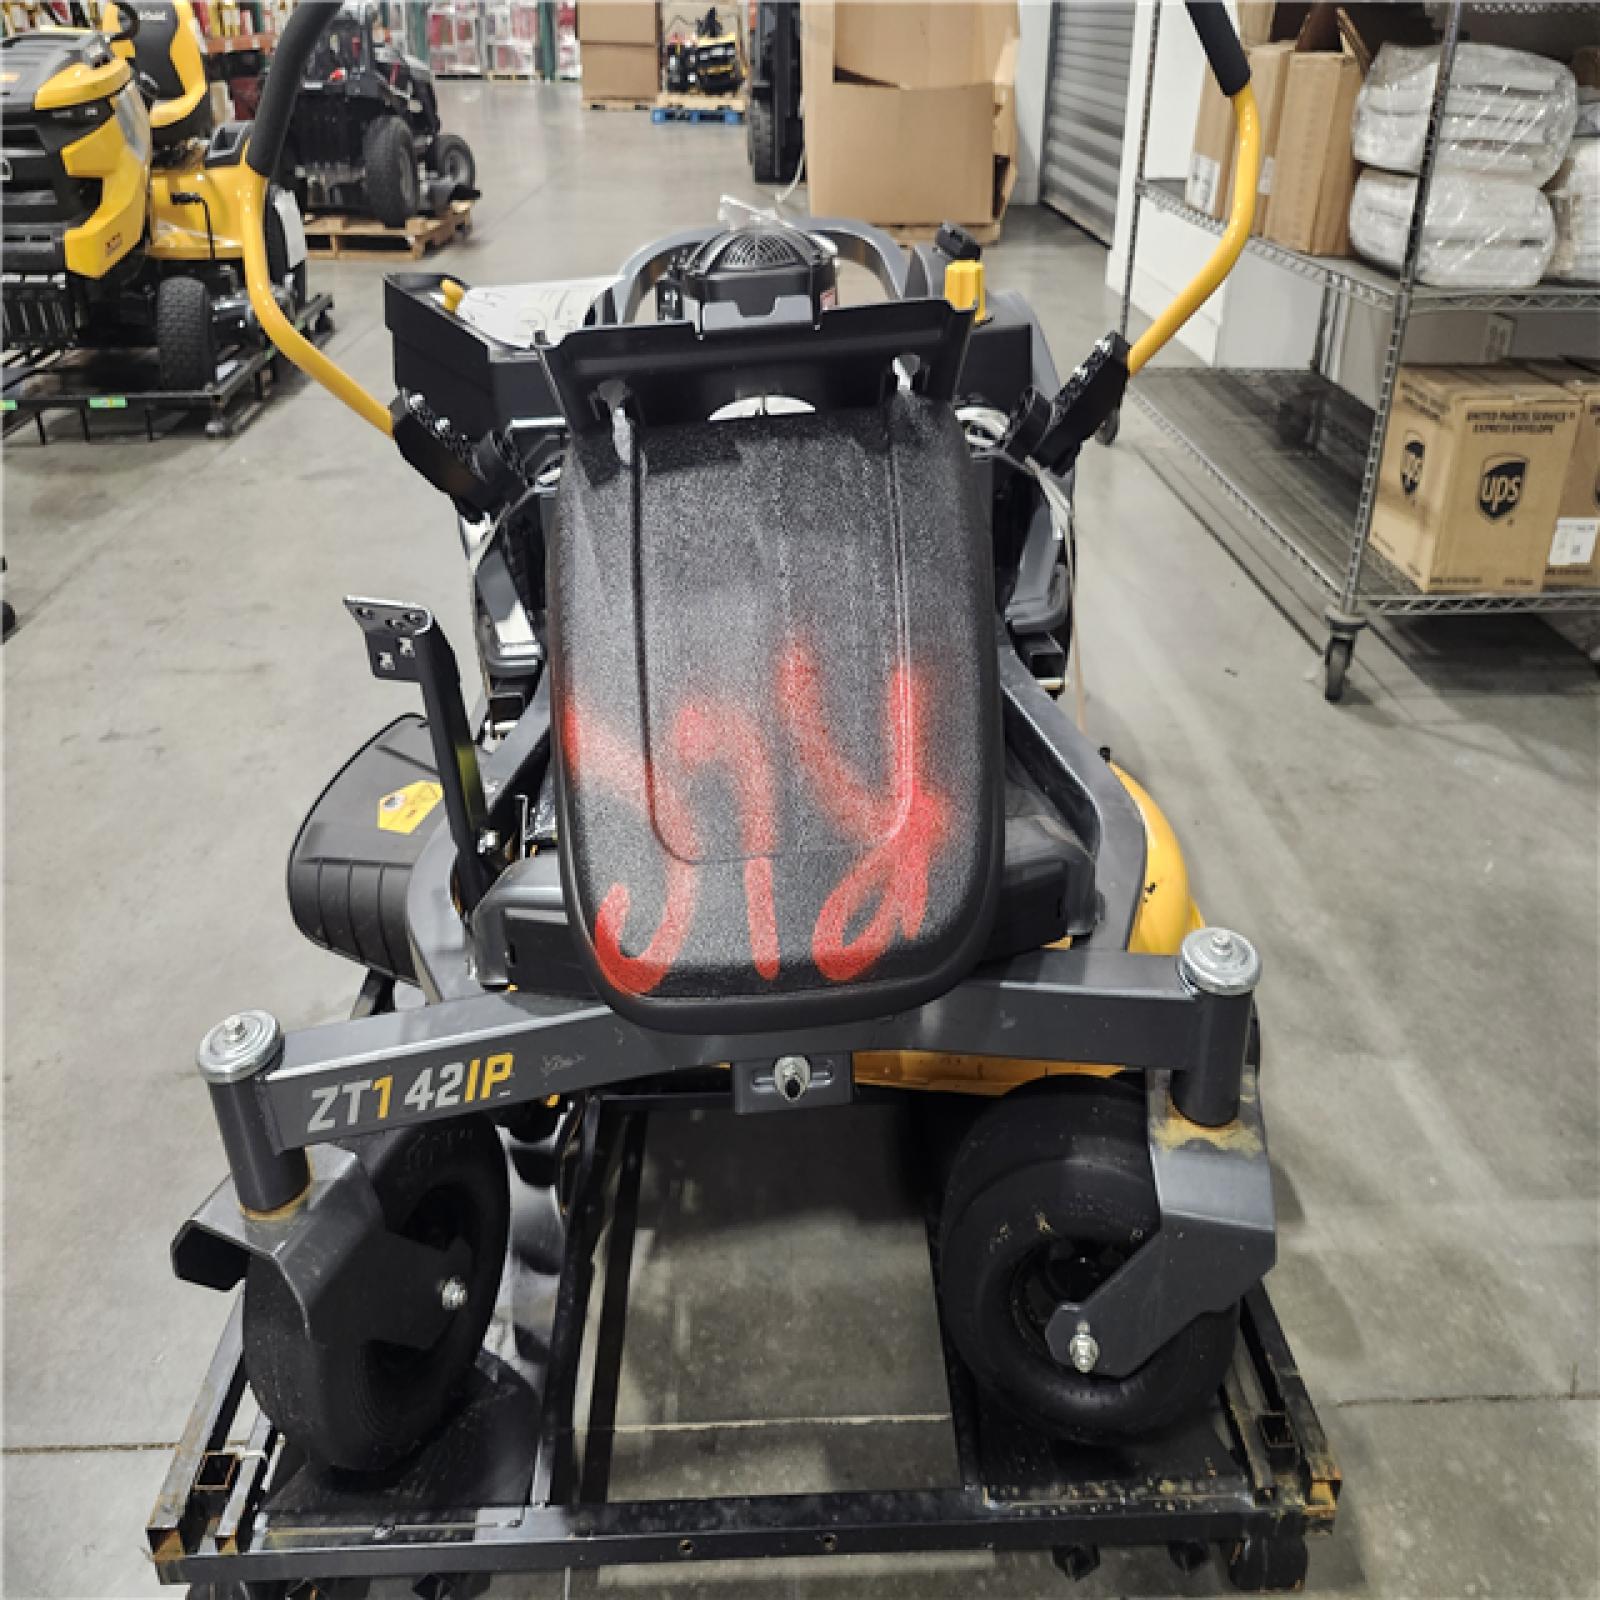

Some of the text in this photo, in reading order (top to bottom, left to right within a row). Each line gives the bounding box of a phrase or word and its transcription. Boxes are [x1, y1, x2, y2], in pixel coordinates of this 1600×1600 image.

[1482, 474, 1522, 512] ups
[306, 1053, 514, 1133] ZT1 42IP
